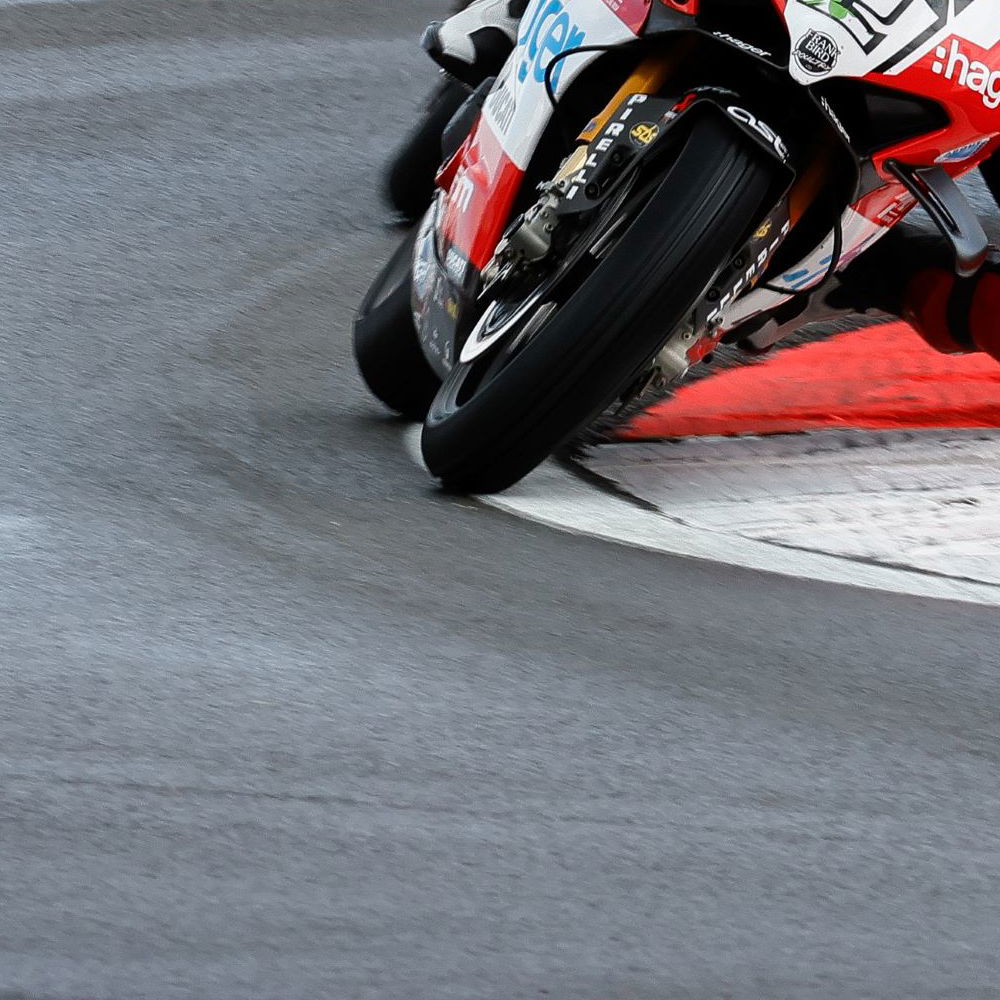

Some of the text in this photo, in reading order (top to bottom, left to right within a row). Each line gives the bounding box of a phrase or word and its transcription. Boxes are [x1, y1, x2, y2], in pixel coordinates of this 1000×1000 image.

[805, 41, 830, 63] BIRD
[807, 29, 839, 57] FRANK
[565, 93, 648, 200] PIRELLI
